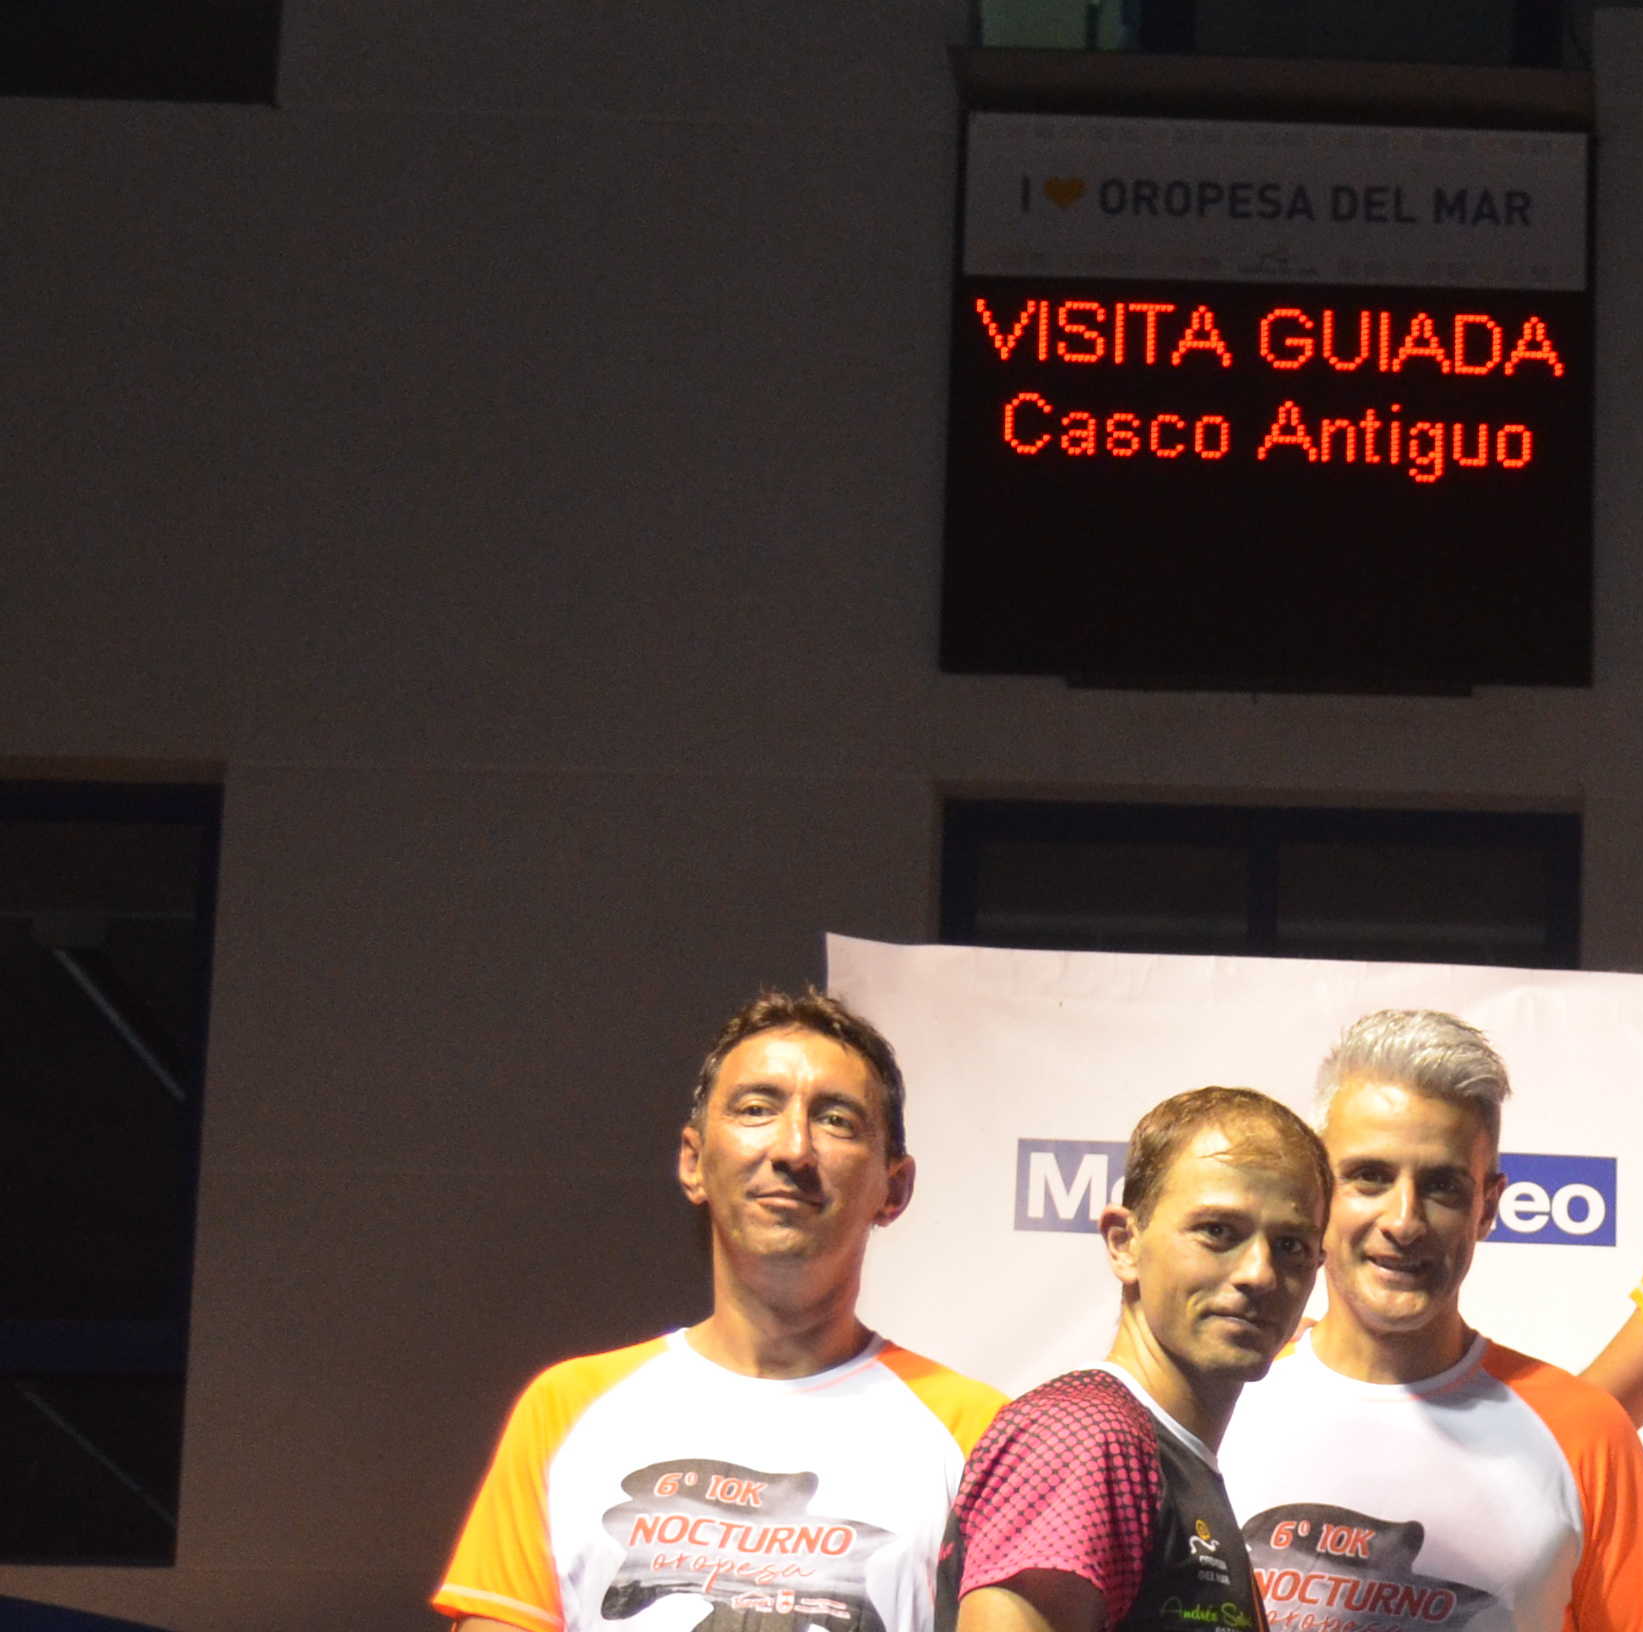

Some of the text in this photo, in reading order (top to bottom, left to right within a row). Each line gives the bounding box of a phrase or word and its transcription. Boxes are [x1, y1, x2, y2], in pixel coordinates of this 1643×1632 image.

[1099, 177, 1316, 223] OROPESA
[1332, 184, 1417, 225] DEL
[1432, 187, 1533, 228] MAR
[975, 298, 1564, 377] VISITA GUIADA
[1003, 391, 1534, 482] Casco Antiguo
[705, 1473, 768, 1508] 10K
[628, 1513, 857, 1557] NOCTURNO
[1316, 1523, 1376, 1559] 10K
[1253, 1568, 1457, 1623] NOCTURNO
